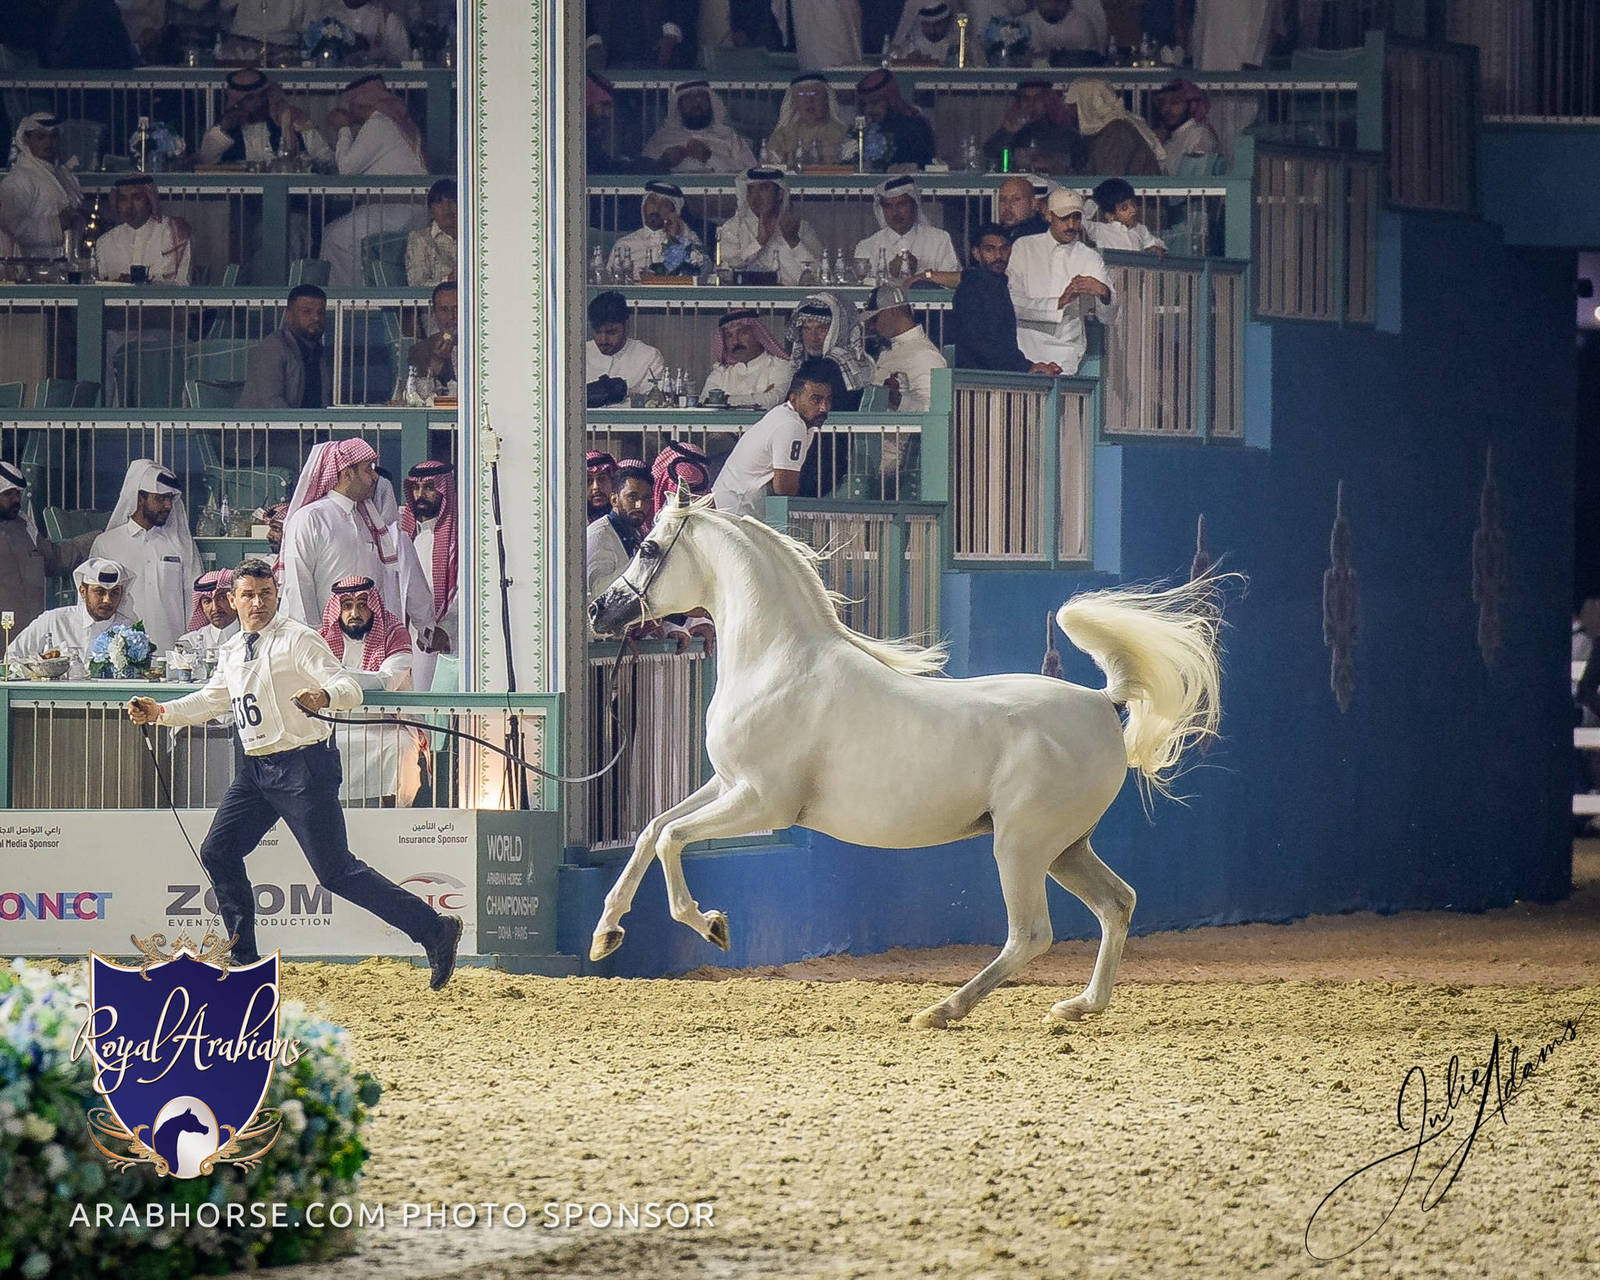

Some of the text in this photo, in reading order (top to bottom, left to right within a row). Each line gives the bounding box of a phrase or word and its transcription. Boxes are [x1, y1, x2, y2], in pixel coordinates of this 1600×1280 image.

[790, 440, 802, 461] 8
[16, 826, 43, 835] التواصل
[44, 825, 61, 837] راعي
[412, 820, 454, 832] راعي التأمين
[5, 839, 27, 848] Media
[28, 838, 60, 850] Sponsor
[398, 835, 468, 845] Insurance Sponsor
[487, 834, 523, 862] WORLD
[0, 892, 112, 920] ONNECT
[425, 893, 468, 910] IC
[486, 895, 539, 916] CHAMPIONSHIP
[168, 918, 331, 927] EVENTS RODUCTION
